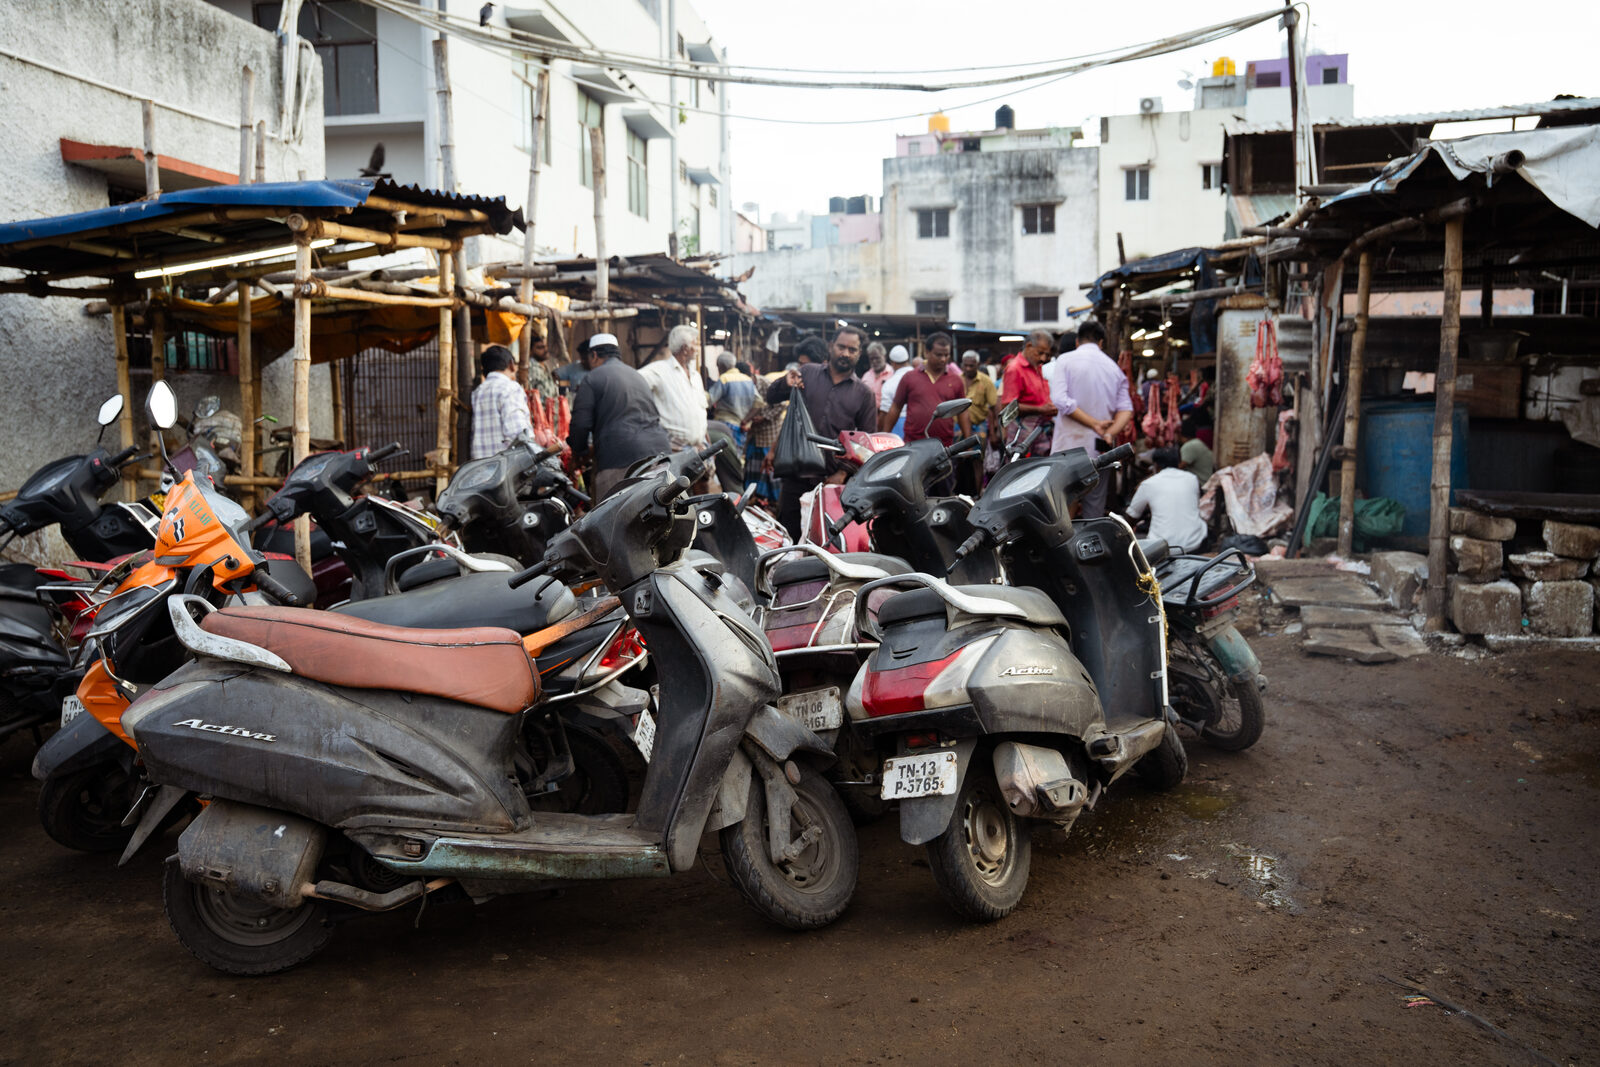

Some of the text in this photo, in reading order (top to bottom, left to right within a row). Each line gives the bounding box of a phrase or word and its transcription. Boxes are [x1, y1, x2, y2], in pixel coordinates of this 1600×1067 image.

[998, 666, 1053, 677] Activa
[795, 703, 808, 717] TN
[171, 719, 277, 742] Activa
[898, 761, 937, 779] TN-13
[894, 776, 940, 795] P-5765
